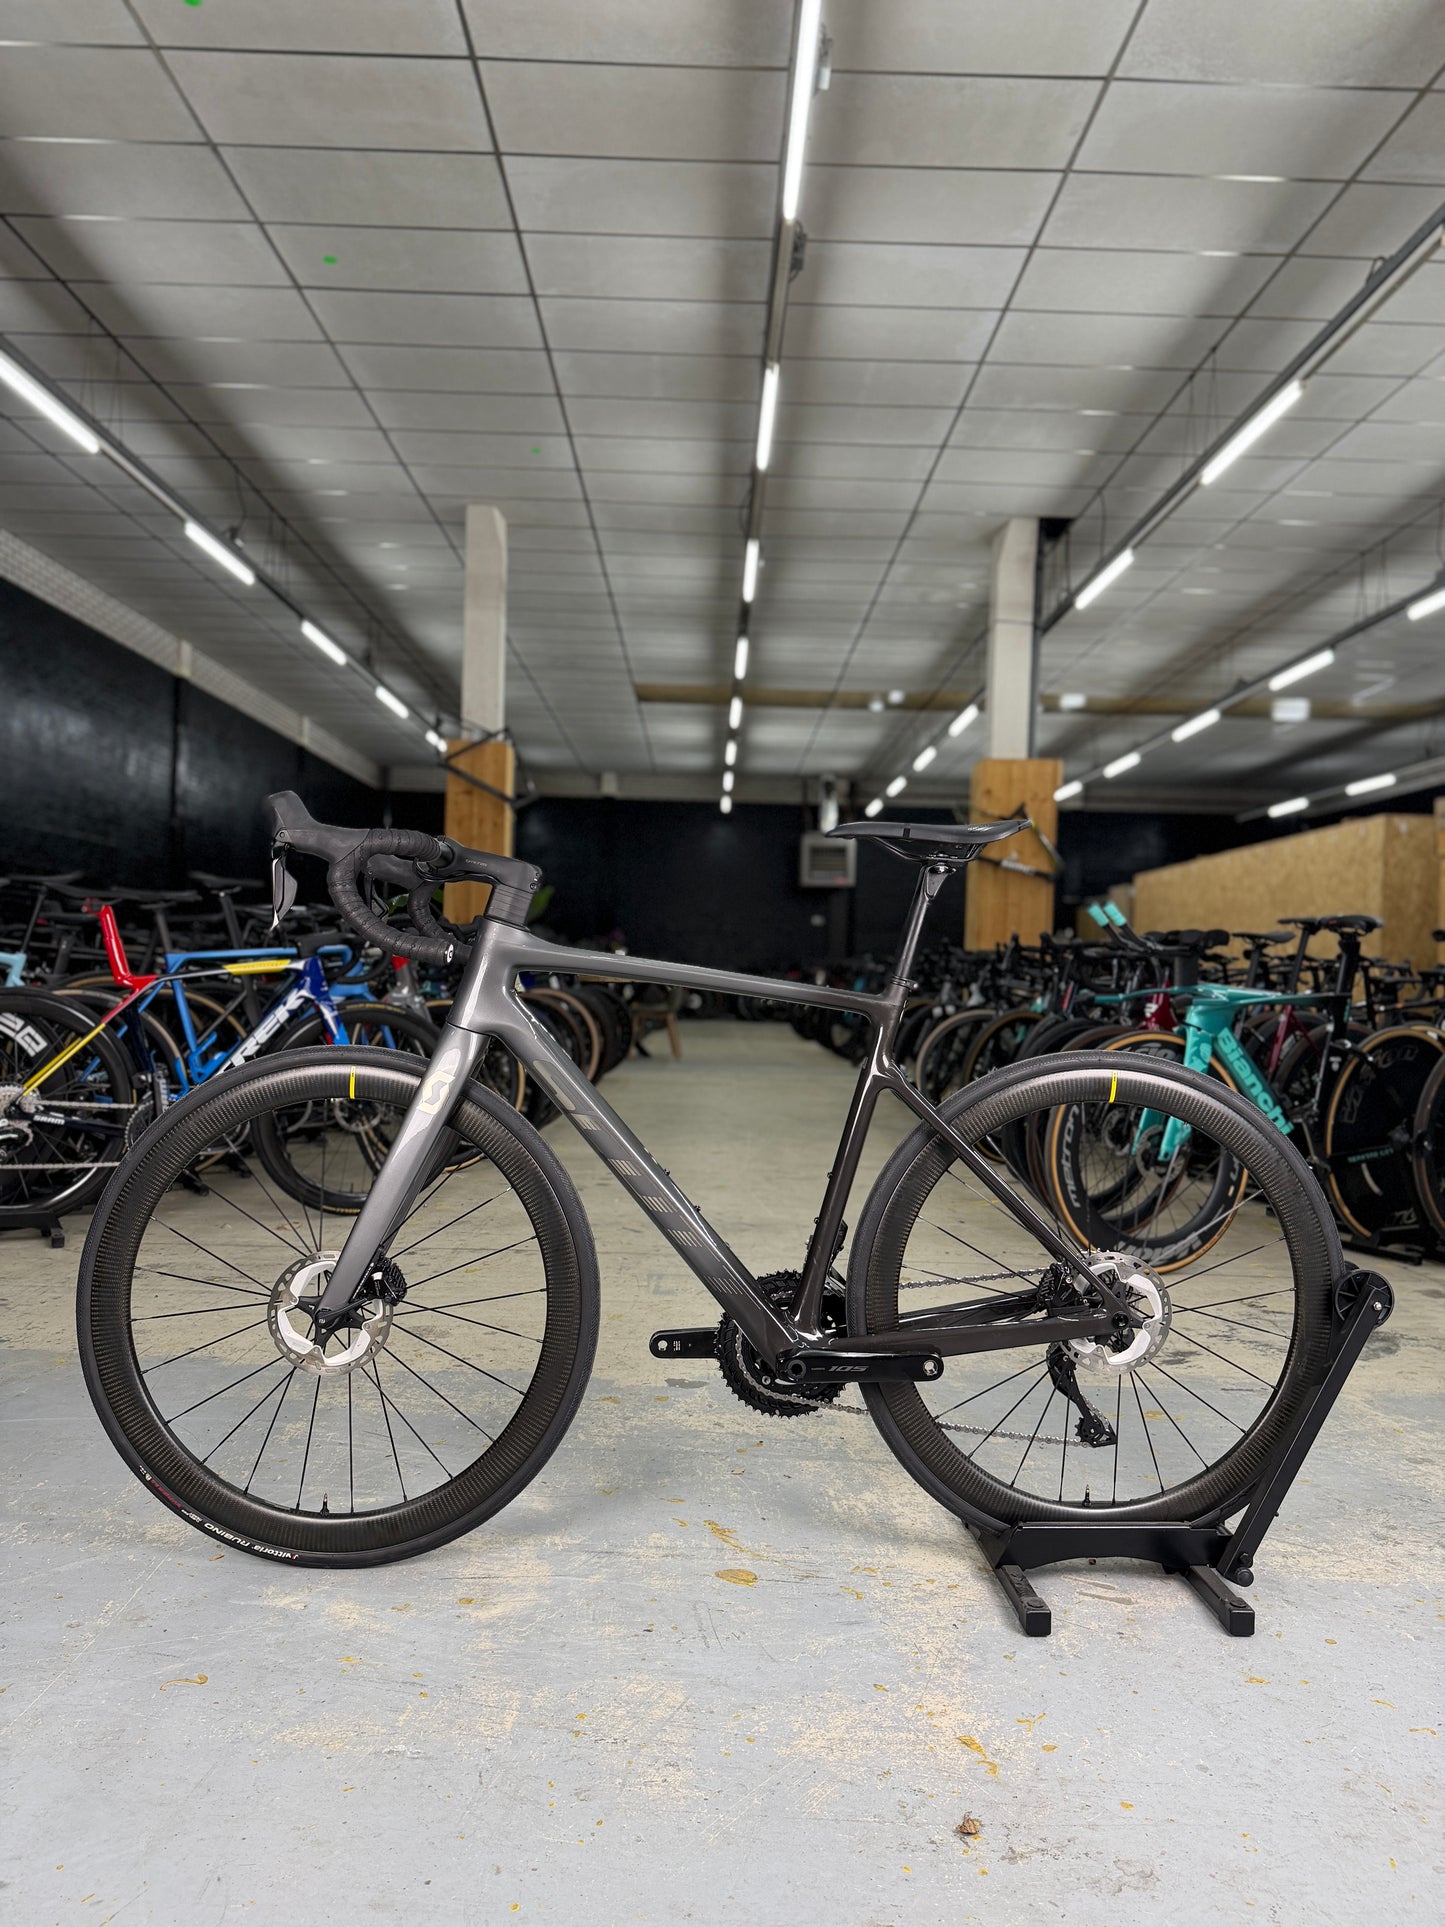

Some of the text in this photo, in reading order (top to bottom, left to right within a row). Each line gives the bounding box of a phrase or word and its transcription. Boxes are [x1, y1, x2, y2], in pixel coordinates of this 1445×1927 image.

[1217, 1027, 1295, 1135] Bianchi
[204, 1522, 292, 1559] vittoria RUBINO
